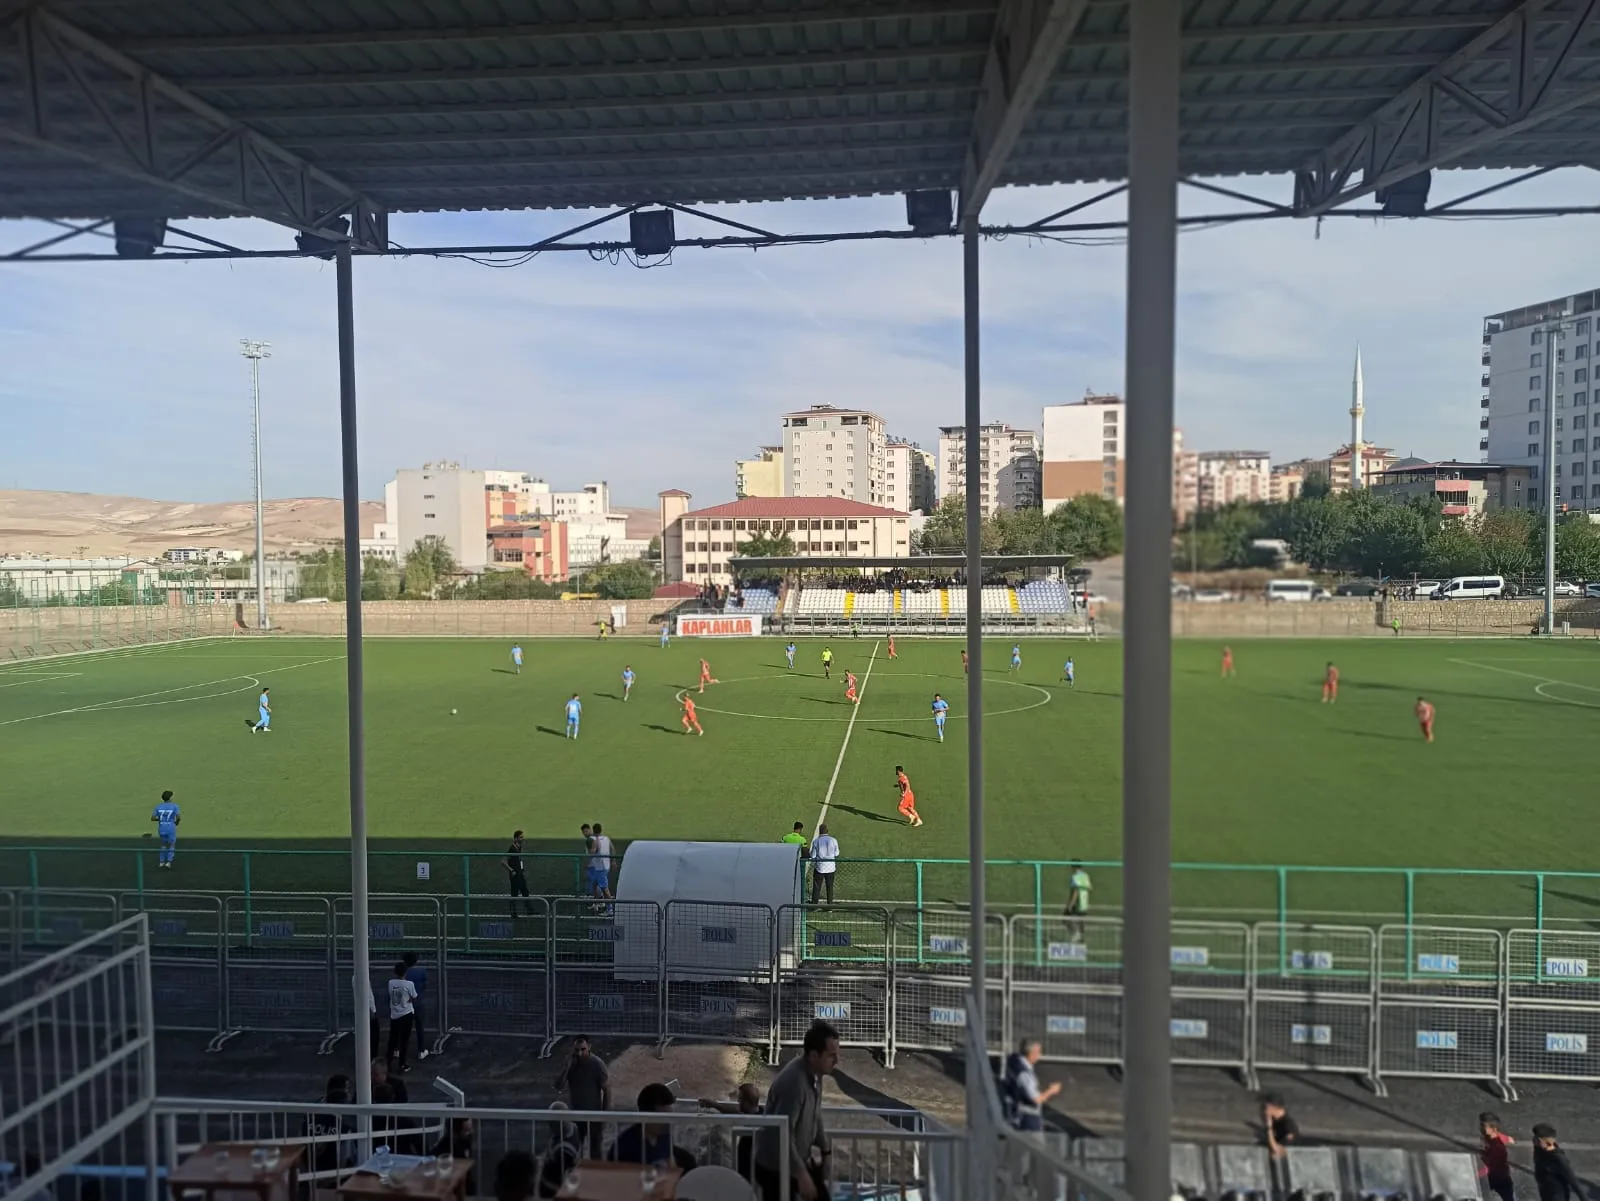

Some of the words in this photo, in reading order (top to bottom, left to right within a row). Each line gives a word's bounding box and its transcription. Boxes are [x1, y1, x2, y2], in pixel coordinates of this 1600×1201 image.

[682, 619, 752, 635] KAPLANLAR
[158, 809, 173, 821] 77
[592, 926, 620, 940] POLİS
[1551, 959, 1584, 975] POLİS
[593, 995, 621, 1010] POLİS
[819, 1003, 848, 1018] POLİS
[1550, 1034, 1583, 1050] POLİS
